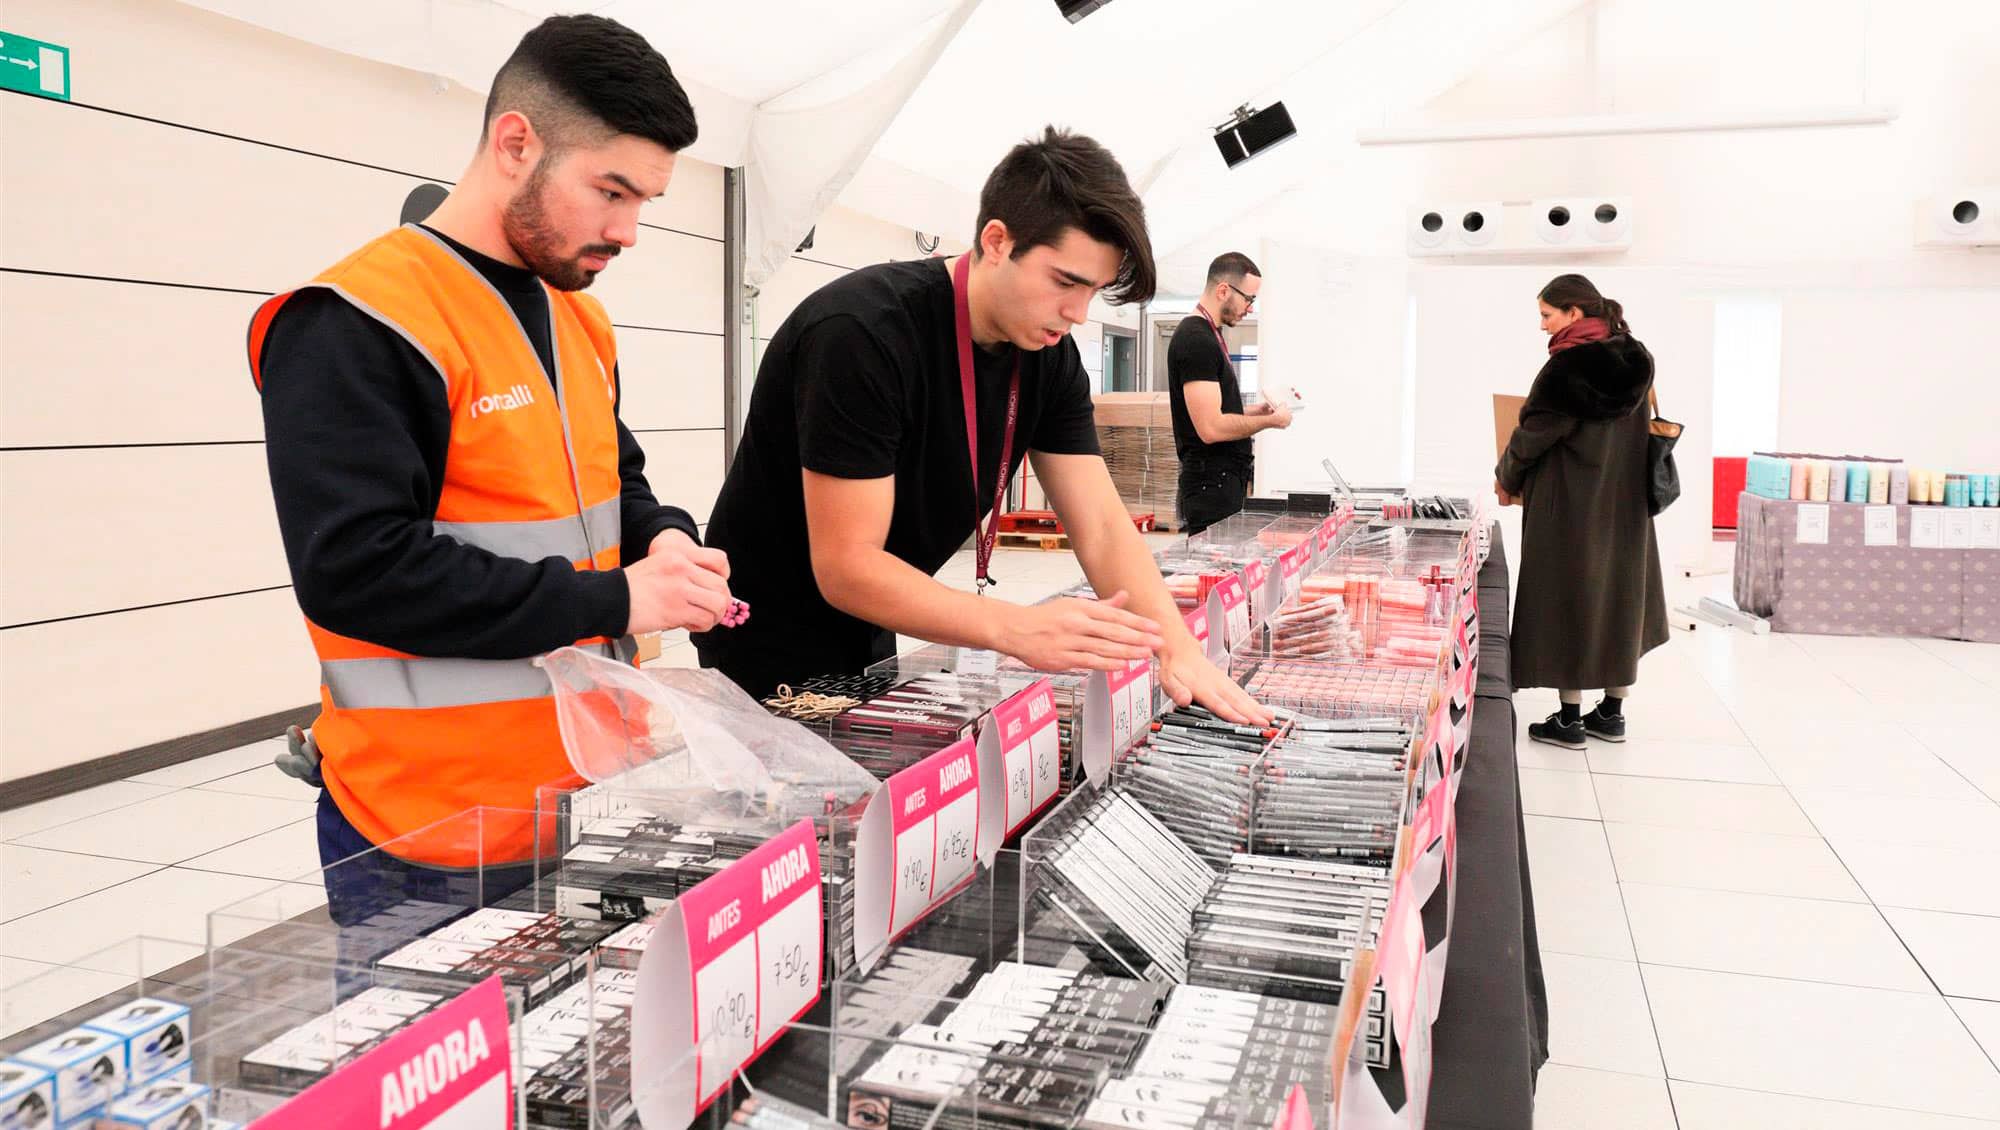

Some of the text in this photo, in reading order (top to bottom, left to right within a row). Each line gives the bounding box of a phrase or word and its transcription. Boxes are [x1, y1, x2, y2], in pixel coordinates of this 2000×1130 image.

[904, 754, 973, 816] ANTES AHORA
[707, 843, 811, 944] ANTES AHORA
[380, 1017, 491, 1129] AHORA
